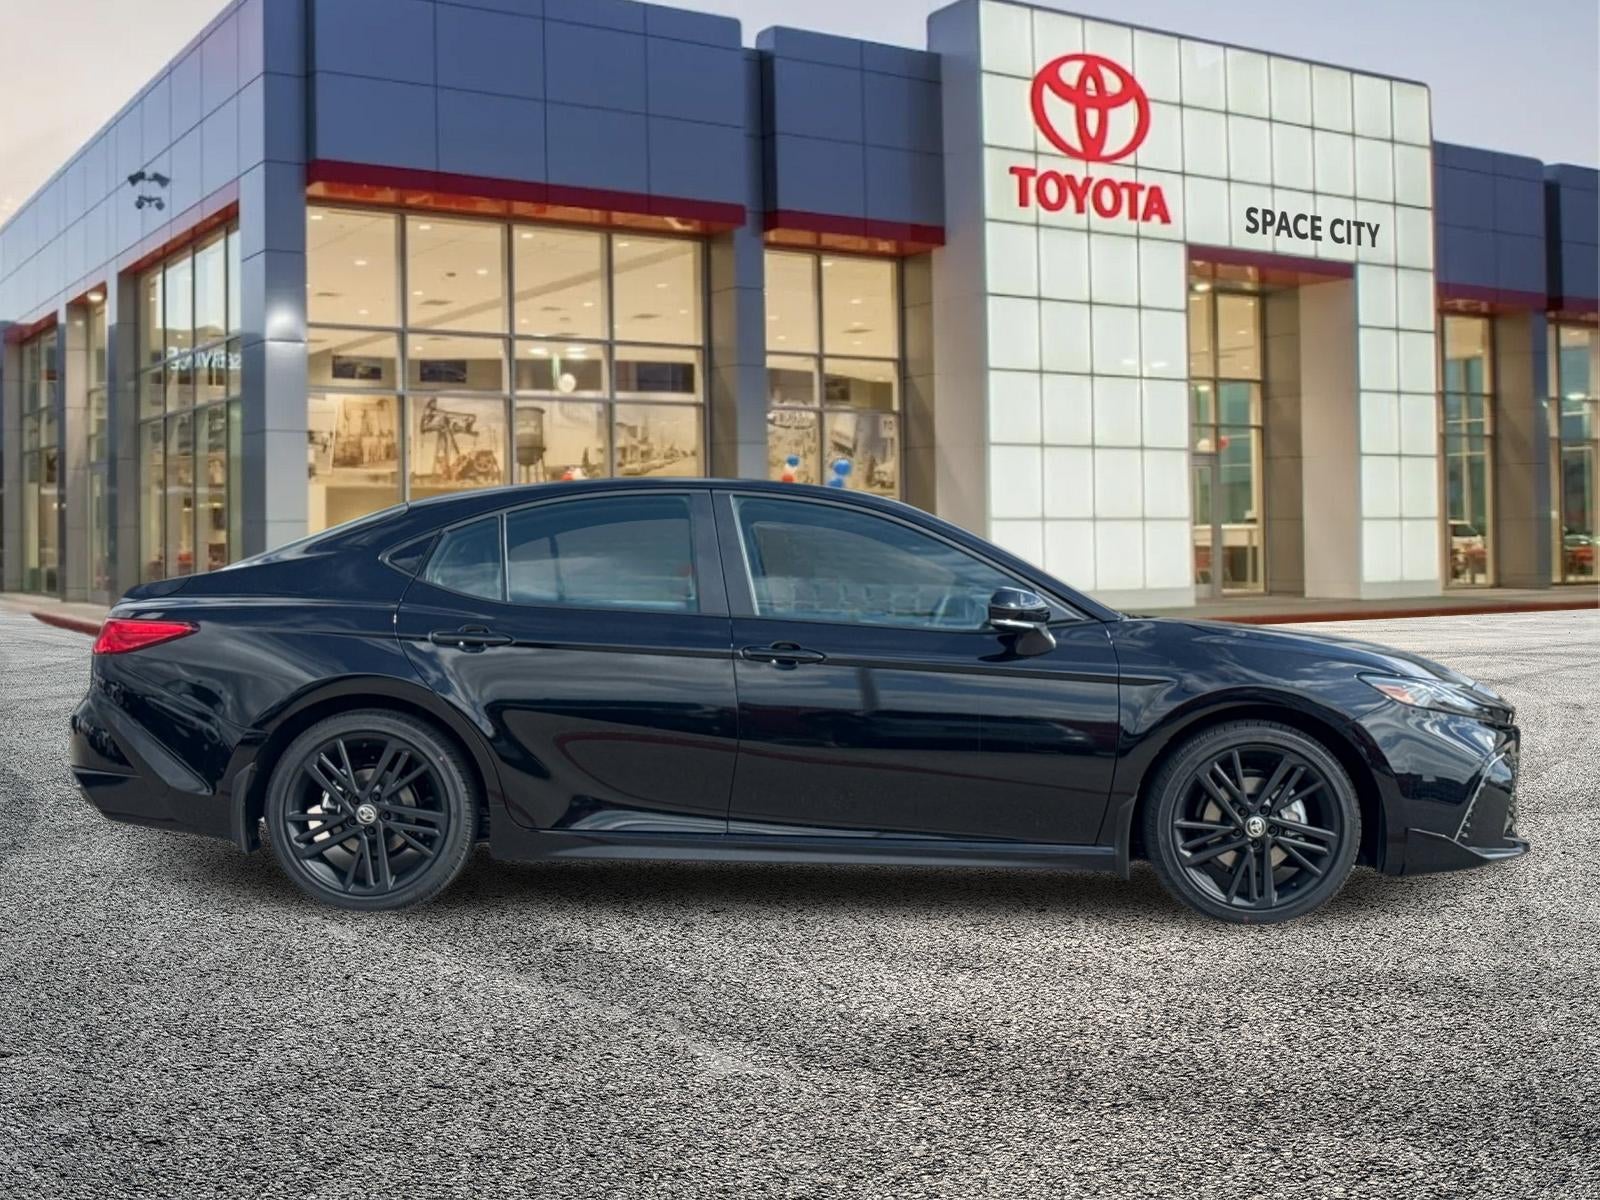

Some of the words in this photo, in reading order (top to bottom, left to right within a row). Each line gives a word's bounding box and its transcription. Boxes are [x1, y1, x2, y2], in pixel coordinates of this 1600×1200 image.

[1009, 166, 1171, 224] TOYOTA
[1245, 207, 1322, 242] SPACE
[1329, 218, 1381, 248] CITY
